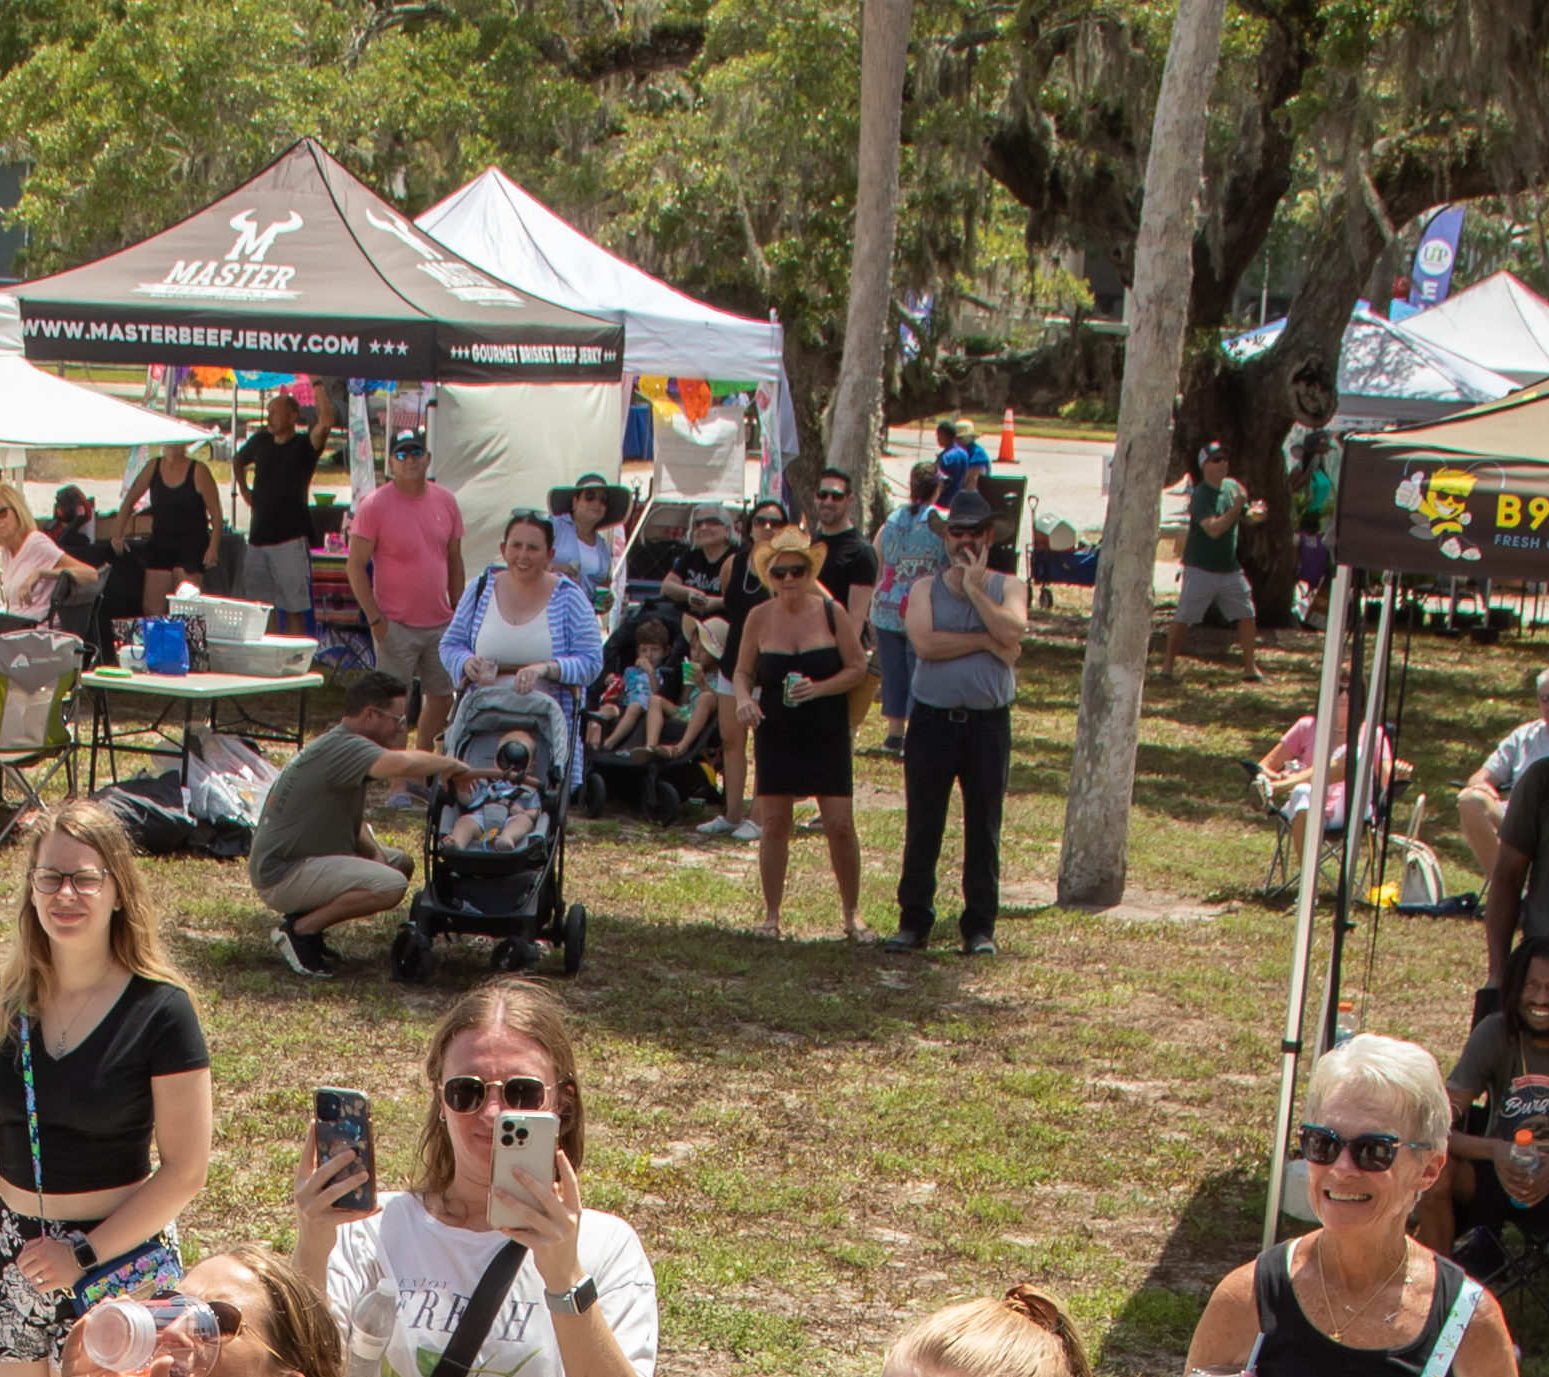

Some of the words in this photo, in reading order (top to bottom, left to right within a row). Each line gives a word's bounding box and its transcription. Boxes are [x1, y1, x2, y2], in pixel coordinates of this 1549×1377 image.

[163, 260, 296, 290] MASTER
[22, 319, 359, 355] WWW.MASTERBEEFJERKY.COM
[471, 344, 517, 363] GOURMET
[519, 345, 554, 363] BRISKET
[555, 345, 577, 363] BEEF
[578, 346, 602, 364] JERKY
[1494, 533, 1541, 550] FRESH
[398, 1277, 452, 1290] ENJOY
[395, 1289, 540, 1343] FREH
